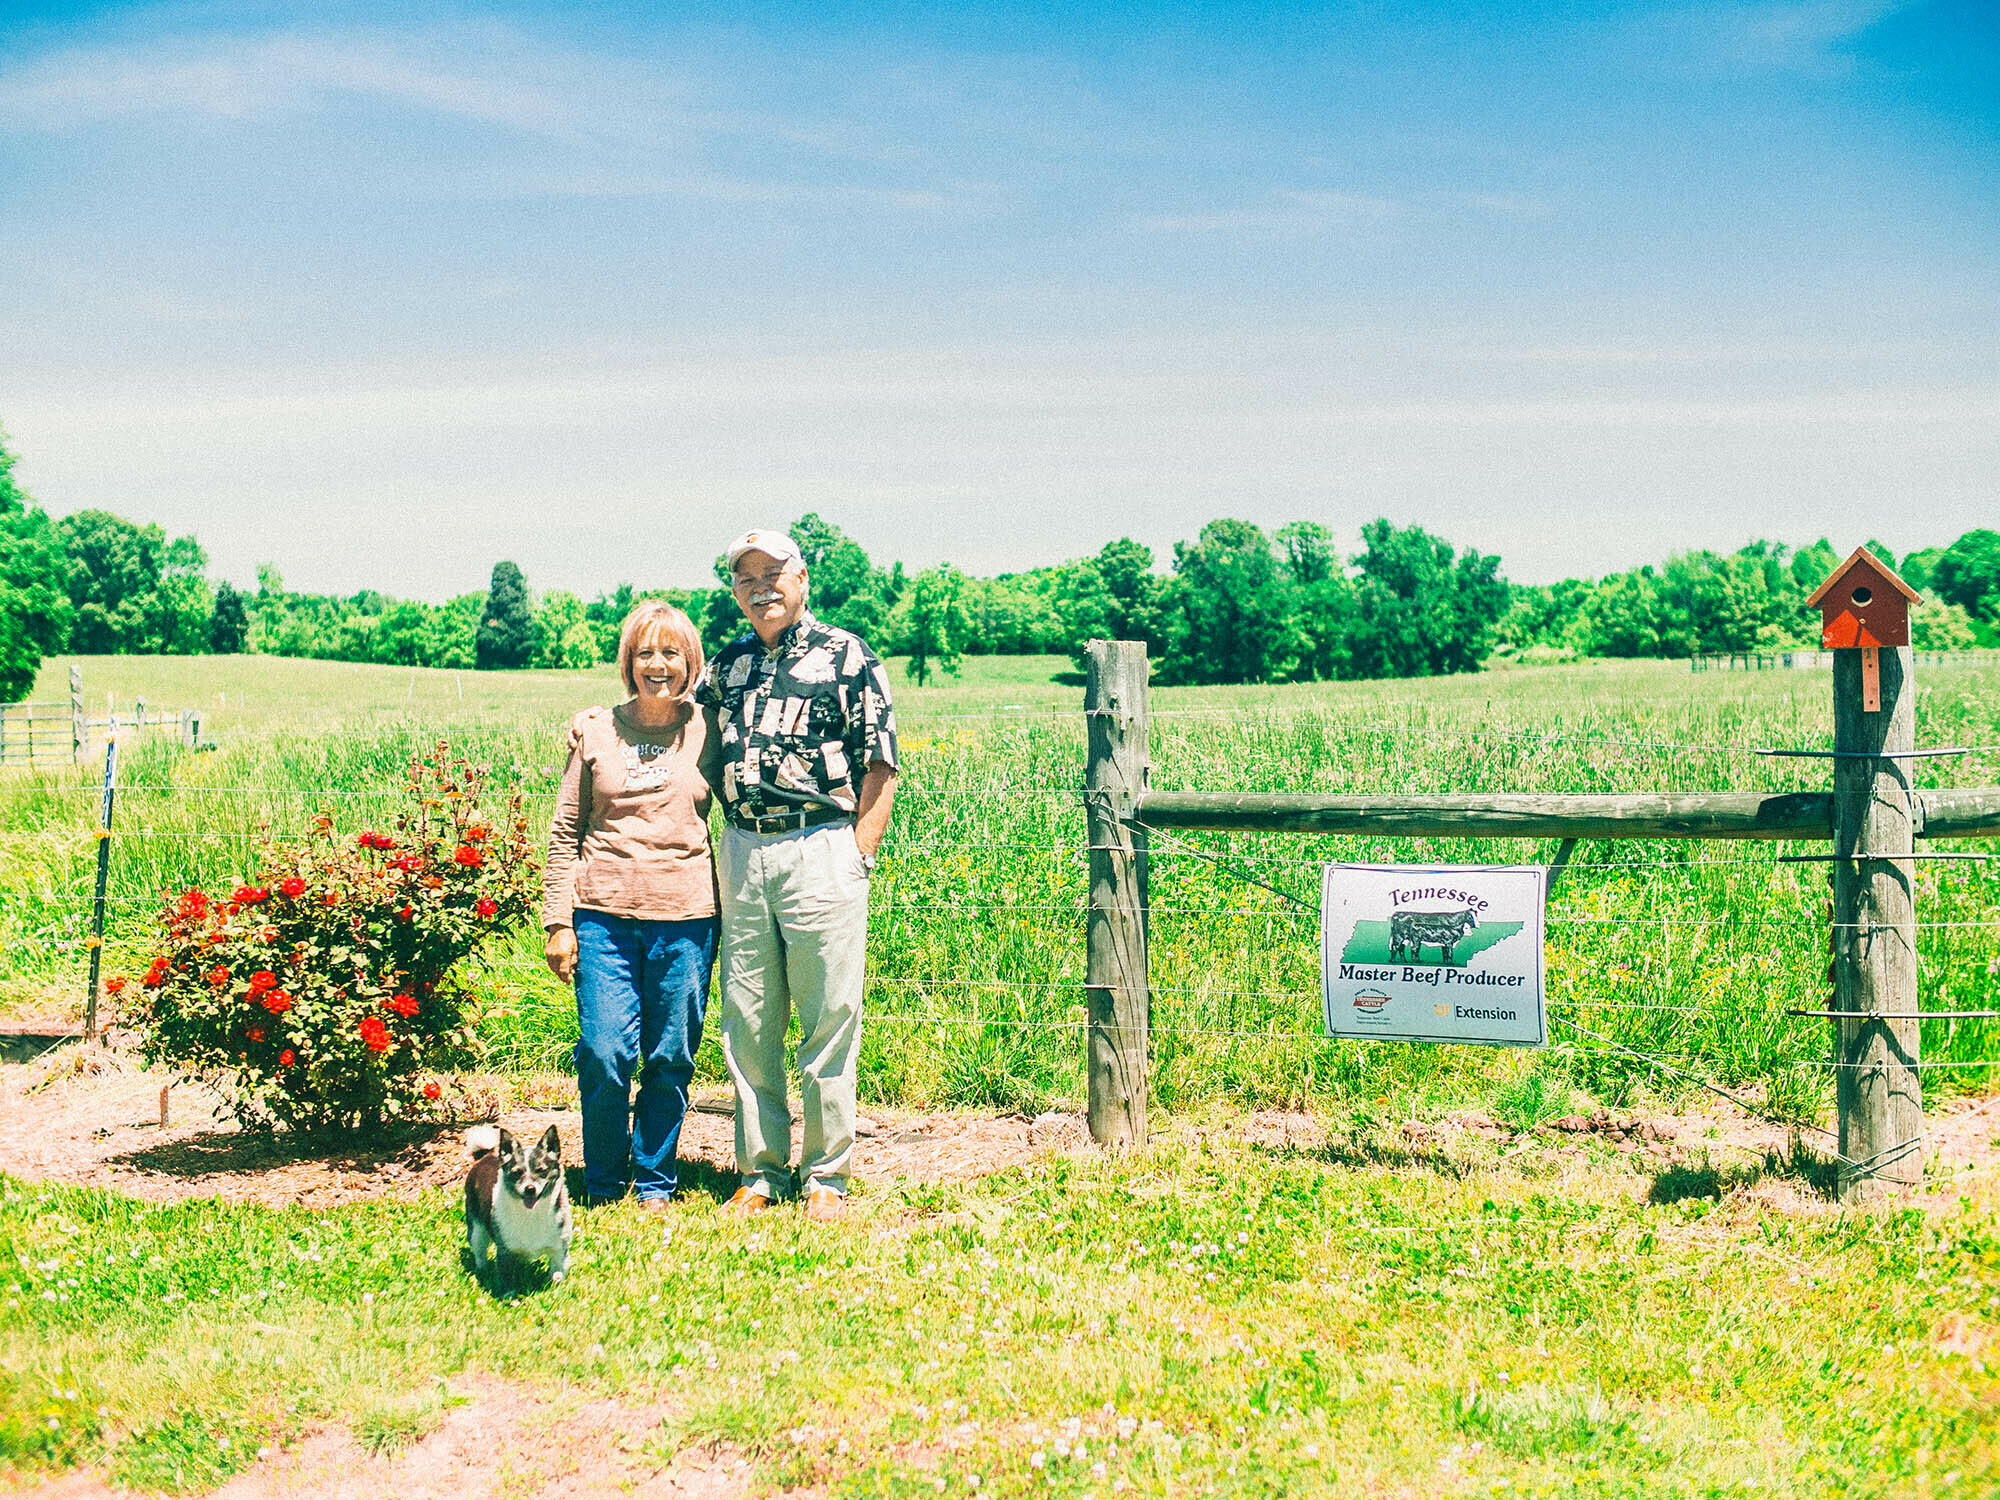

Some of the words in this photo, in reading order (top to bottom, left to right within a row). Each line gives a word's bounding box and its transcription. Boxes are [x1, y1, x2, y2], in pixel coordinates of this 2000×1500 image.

[1388, 887, 1489, 911] Tennessee
[1338, 965, 1397, 981] Master
[1401, 967, 1442, 986] Beef
[1445, 969, 1526, 987] Producer
[1455, 1005, 1517, 1021] Extension
